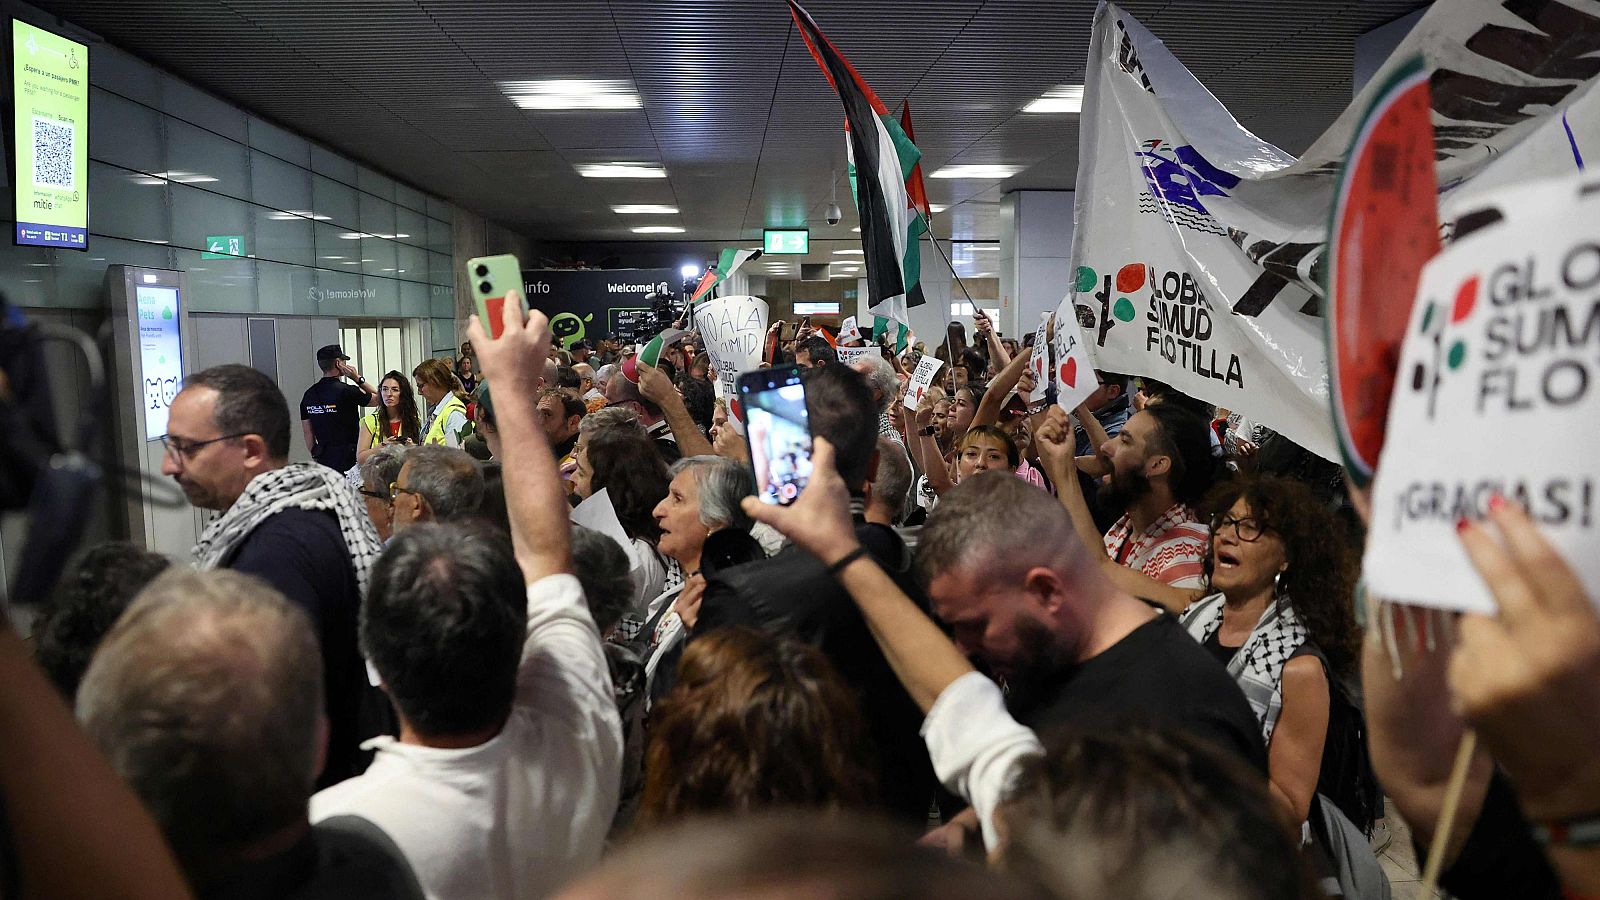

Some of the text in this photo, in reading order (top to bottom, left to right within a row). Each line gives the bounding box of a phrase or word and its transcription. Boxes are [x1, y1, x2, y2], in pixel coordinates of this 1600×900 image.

[33, 198, 53, 210] mitie
[525, 281, 550, 294] info
[607, 282, 655, 294] Welcome!
[1488, 243, 1600, 307] GLO
[139, 308, 155, 320] Pets
[1484, 299, 1600, 361] SUM
[1146, 325, 1244, 389] FLOTILLA
[1477, 359, 1589, 414] FLO
